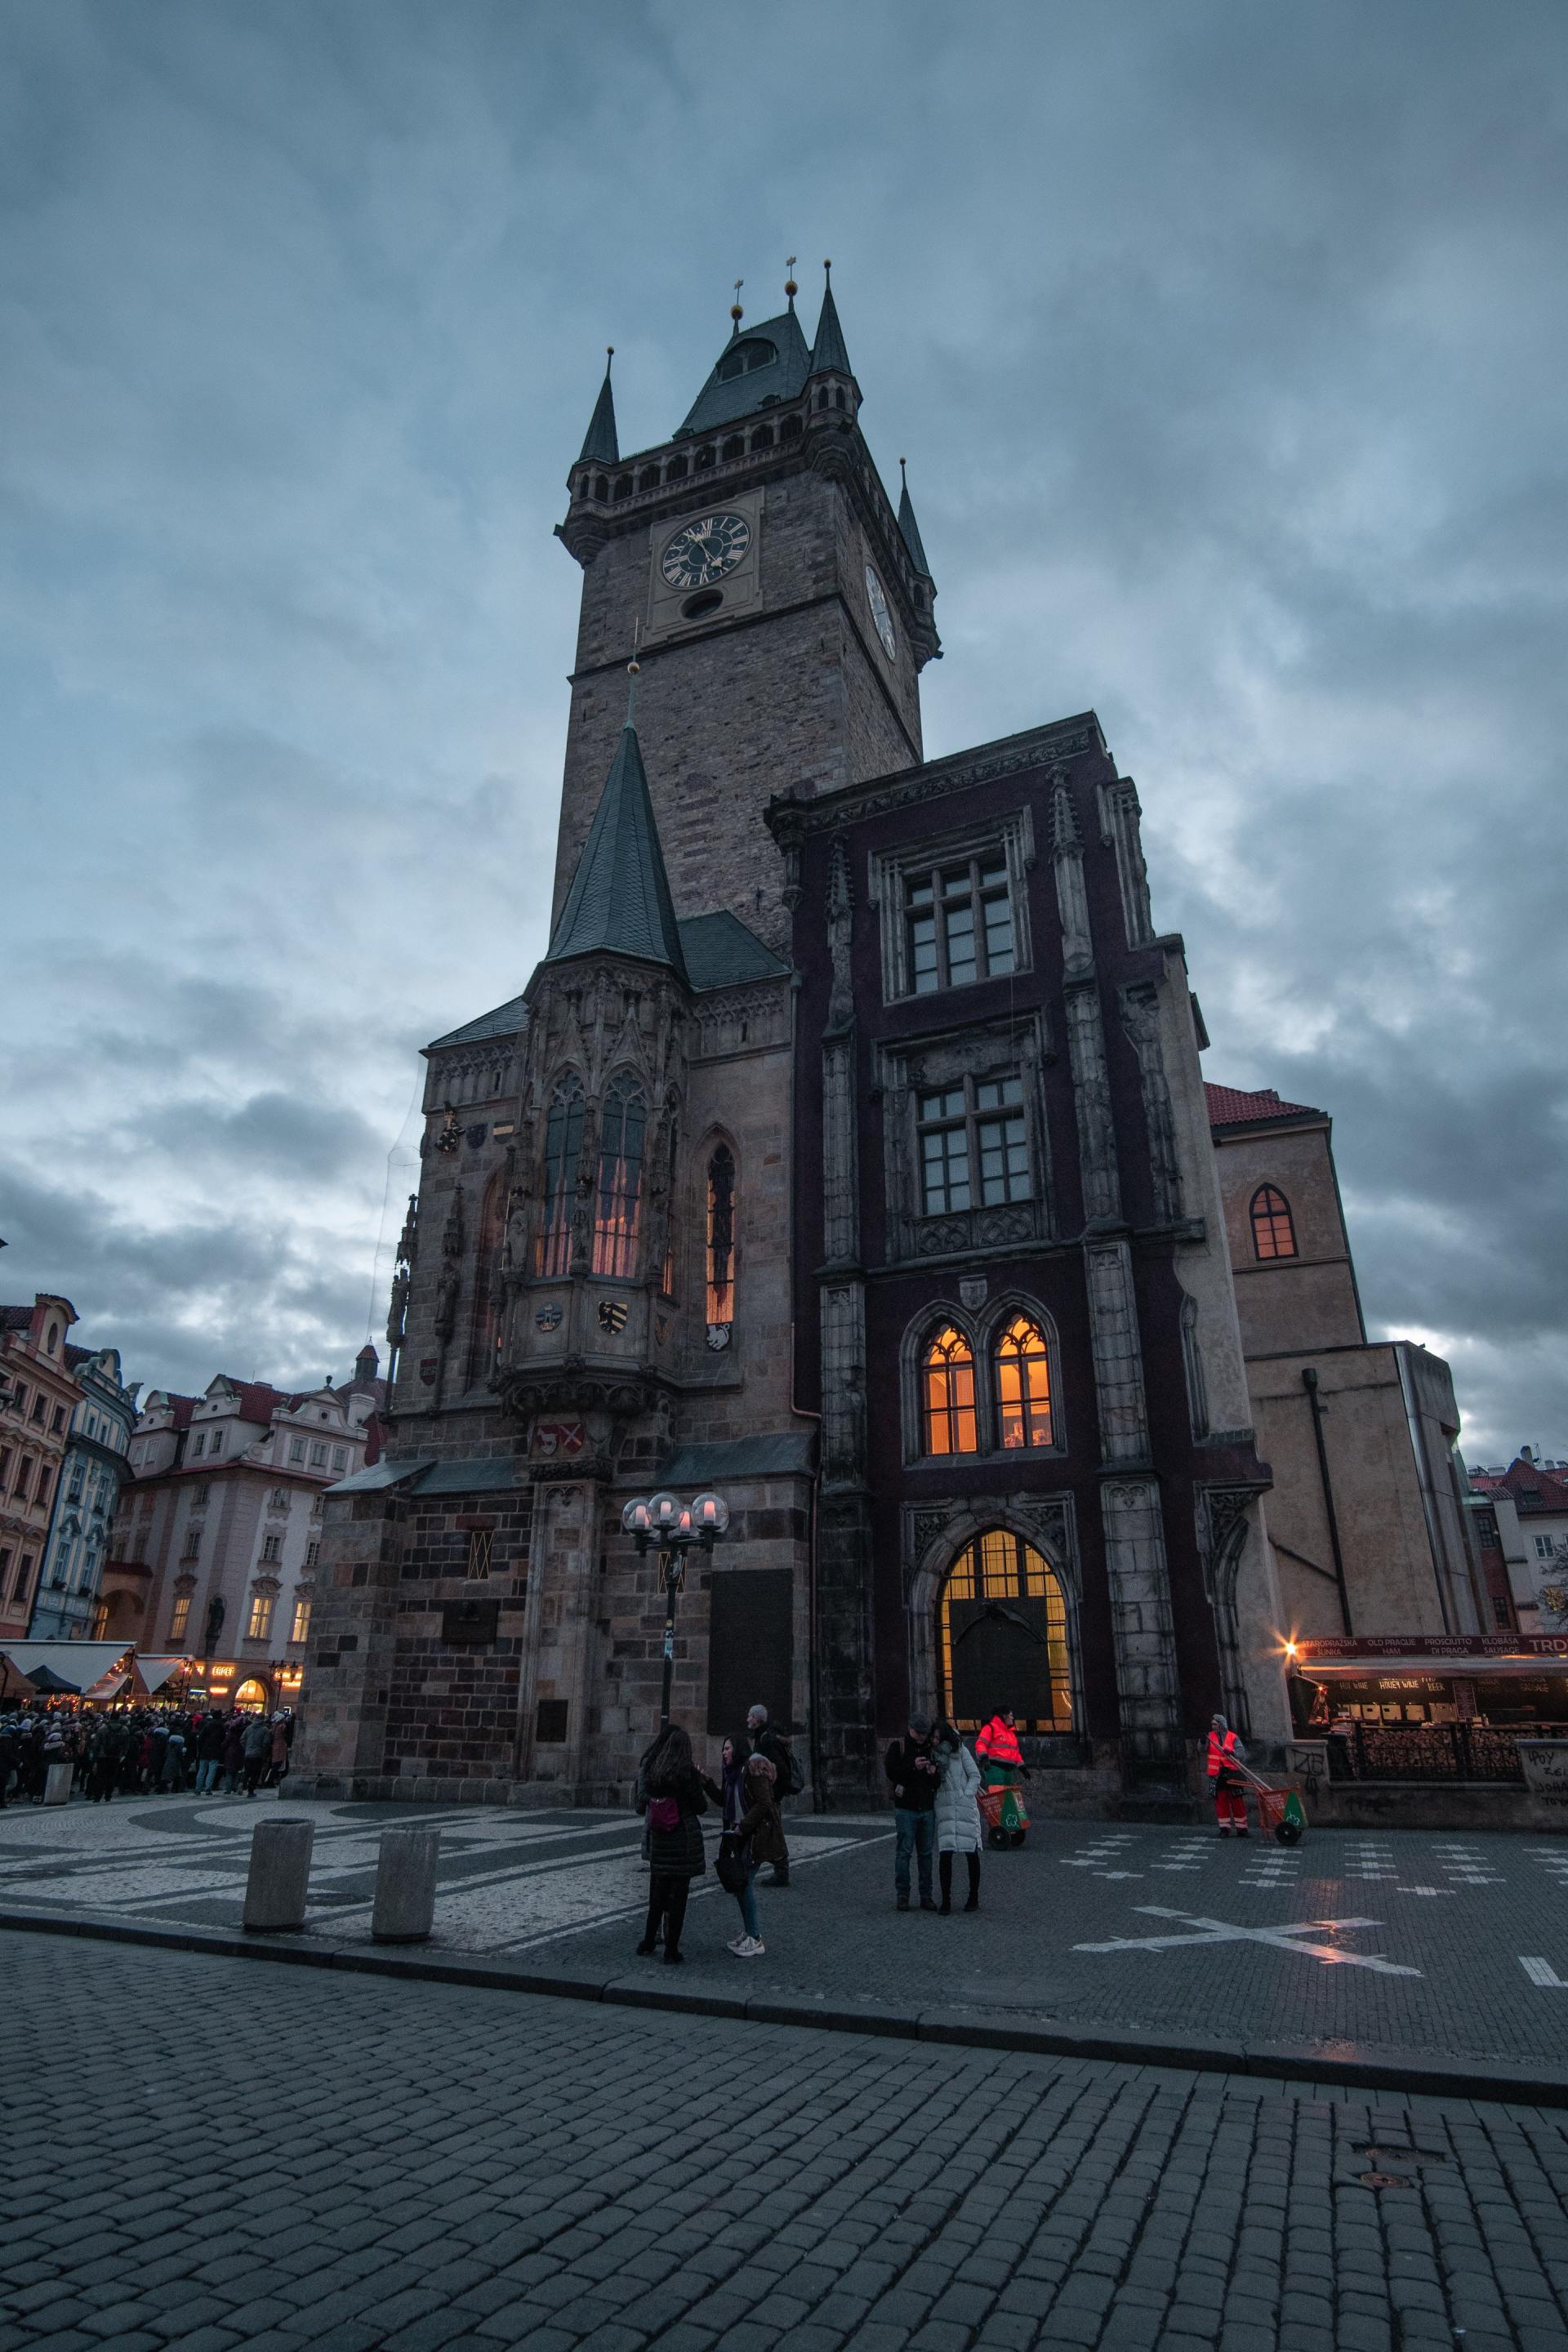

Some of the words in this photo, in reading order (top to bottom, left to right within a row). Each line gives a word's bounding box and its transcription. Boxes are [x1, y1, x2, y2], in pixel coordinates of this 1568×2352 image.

[1367, 1638, 1383, 1646] OLD
[1385, 1638, 1416, 1646] PRAGUE
[1424, 1637, 1472, 1646] PROSCIUTTO
[1529, 1639, 1568, 1652] TRD
[1316, 1647, 1342, 1656] ŠUNKA
[1383, 1647, 1401, 1655] HAM
[1432, 1646, 1440, 1655] DI
[1442, 1646, 1469, 1655] PRAGA
[1484, 1646, 1520, 1655] SAUSAGE
